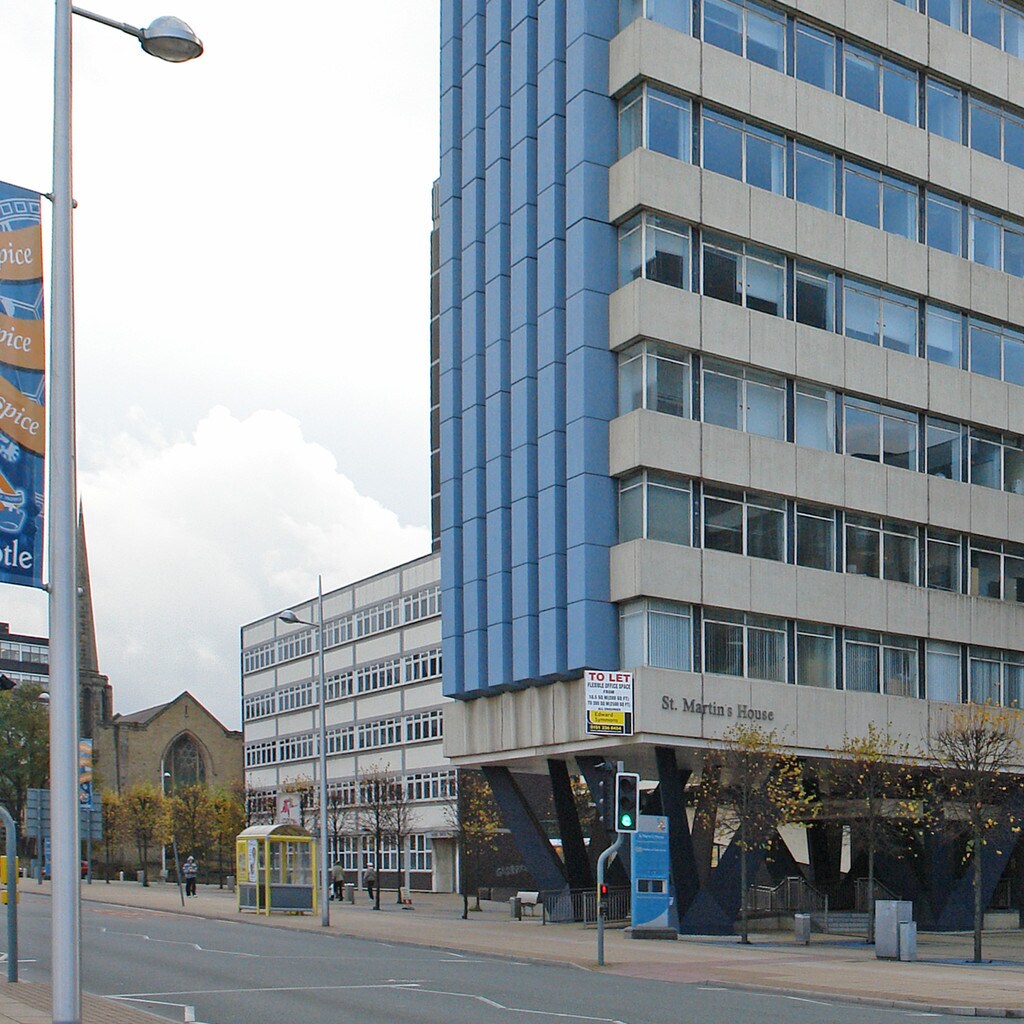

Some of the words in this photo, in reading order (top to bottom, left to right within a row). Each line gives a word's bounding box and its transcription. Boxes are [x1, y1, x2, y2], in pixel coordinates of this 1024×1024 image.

[0, 539, 33, 569] tle
[589, 672, 605, 681] TO
[609, 673, 631, 682] LET
[661, 695, 678, 711] St.
[682, 697, 733, 718] Martin's
[737, 704, 774, 721] House
